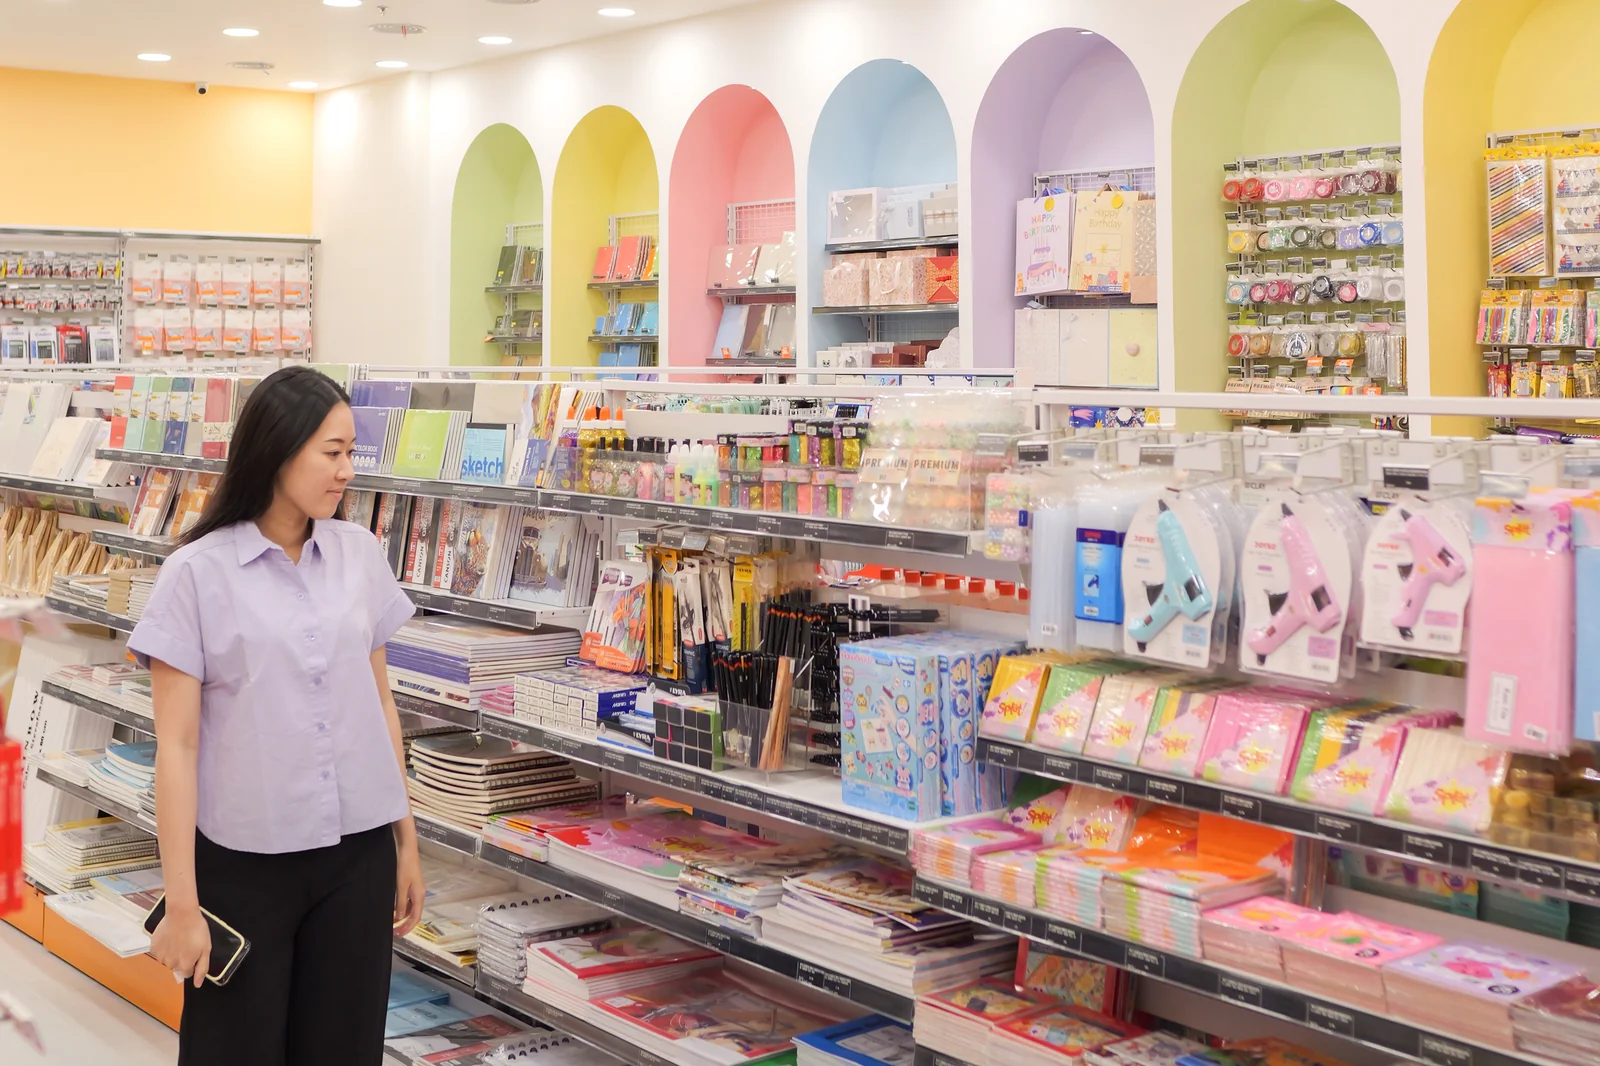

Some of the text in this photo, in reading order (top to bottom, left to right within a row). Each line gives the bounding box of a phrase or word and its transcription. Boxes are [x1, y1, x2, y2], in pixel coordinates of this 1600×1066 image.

[1031, 213, 1055, 224] HAPPY
[1094, 209, 1120, 218] Happy
[1089, 219, 1122, 229] Birthday
[1024, 224, 1060, 239] BIRTHDAY
[461, 455, 504, 479] sketch
[865, 457, 909, 468] PREIUM
[913, 458, 960, 470] PREMIUM
[416, 546, 424, 578] CANSON
[444, 550, 452, 583] CANSON
[635, 732, 651, 743] LYRA
